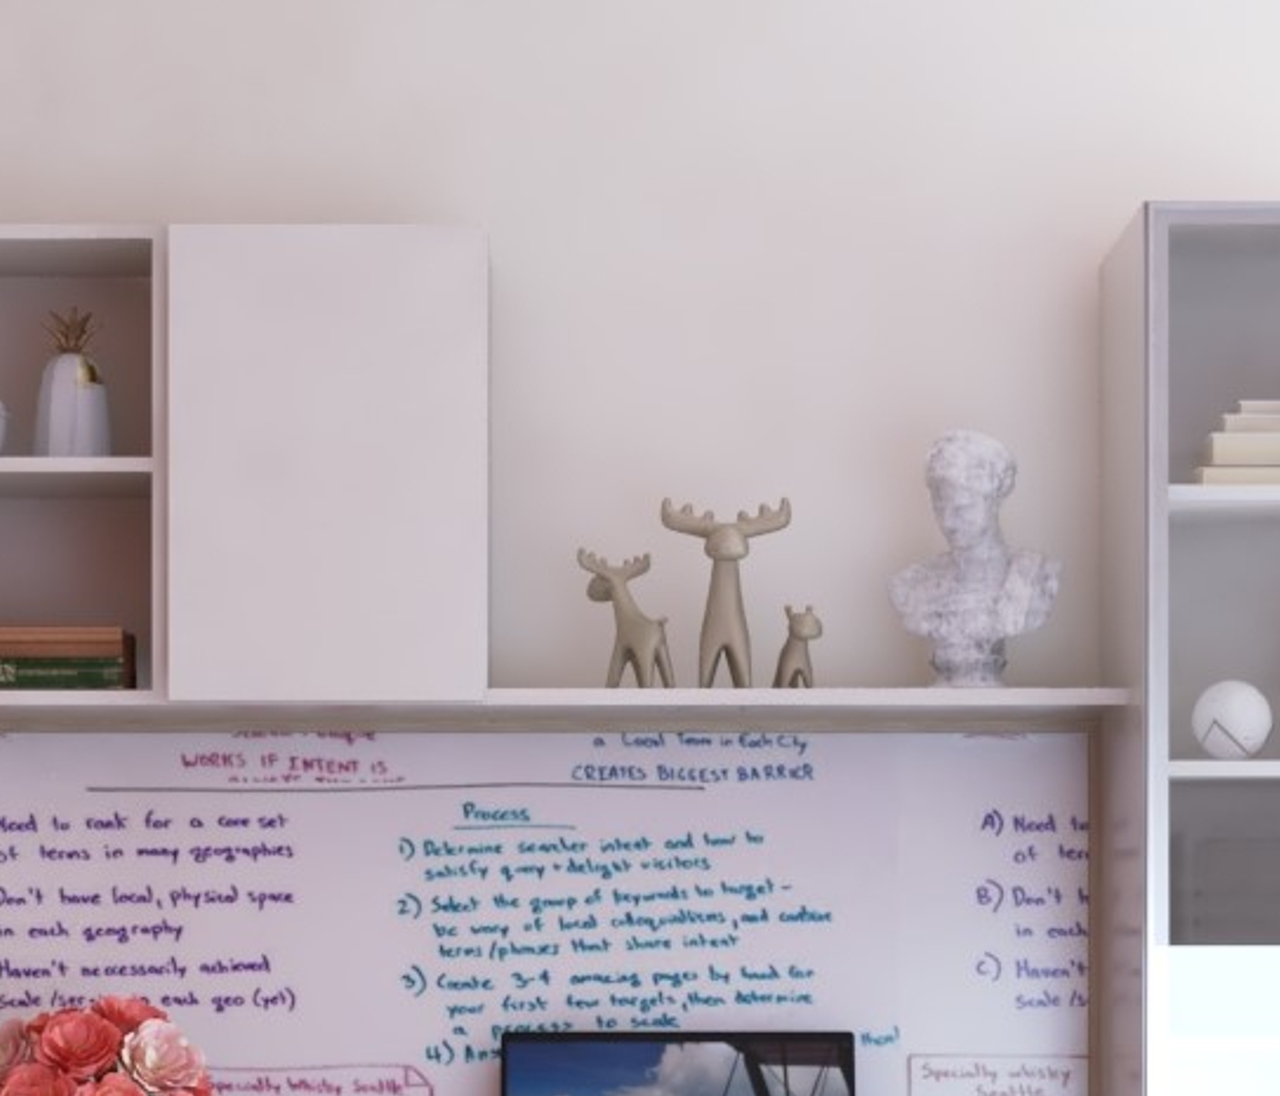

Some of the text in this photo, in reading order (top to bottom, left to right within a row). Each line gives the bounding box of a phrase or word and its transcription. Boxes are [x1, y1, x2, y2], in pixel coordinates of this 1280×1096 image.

[593, 737, 605, 747] a
[181, 752, 388, 775] WORKS IF INTENT IS
[571, 763, 814, 782] CREATES BIGGEST BARRIER
[52, 815, 70, 831] to
[86, 811, 127, 829] rank
[145, 810, 172, 828] for
[190, 817, 204, 828] a
[258, 814, 287, 828] set
[462, 801, 531, 822] Process
[981, 808, 1004, 837] A)
[1012, 813, 1056, 833] Need
[664, 831, 694, 849] and
[704, 832, 736, 846] how
[745, 831, 764, 844] to
[40, 845, 90, 860] terms
[104, 845, 123, 859] in
[137, 847, 179, 865] many
[425, 860, 488, 881] satisfy
[59, 887, 101, 904] have
[247, 891, 294, 911] space
[398, 893, 422, 919] 2)
[431, 895, 480, 913] Select
[493, 893, 520, 908] the
[585, 888, 602, 905] of
[695, 883, 714, 897] to
[976, 878, 1004, 912] B)
[1012, 886, 1062, 907] Don't
[28, 921, 69, 938] each
[83, 919, 183, 943] geography
[433, 923, 457, 937] be
[524, 917, 544, 932] of
[559, 914, 597, 929] local
[741, 908, 768, 922] and
[1015, 924, 1033, 937] in
[683, 933, 738, 948] intent
[199, 954, 271, 973] achieved
[976, 951, 1089, 981] C) Haven't
[401, 965, 427, 997] 3)
[709, 965, 730, 983] by
[161, 991, 198, 1006] each
[211, 996, 245, 1012] geo
[502, 995, 548, 1012] first
[453, 1026, 468, 1036] a
[596, 1016, 617, 1028] to
